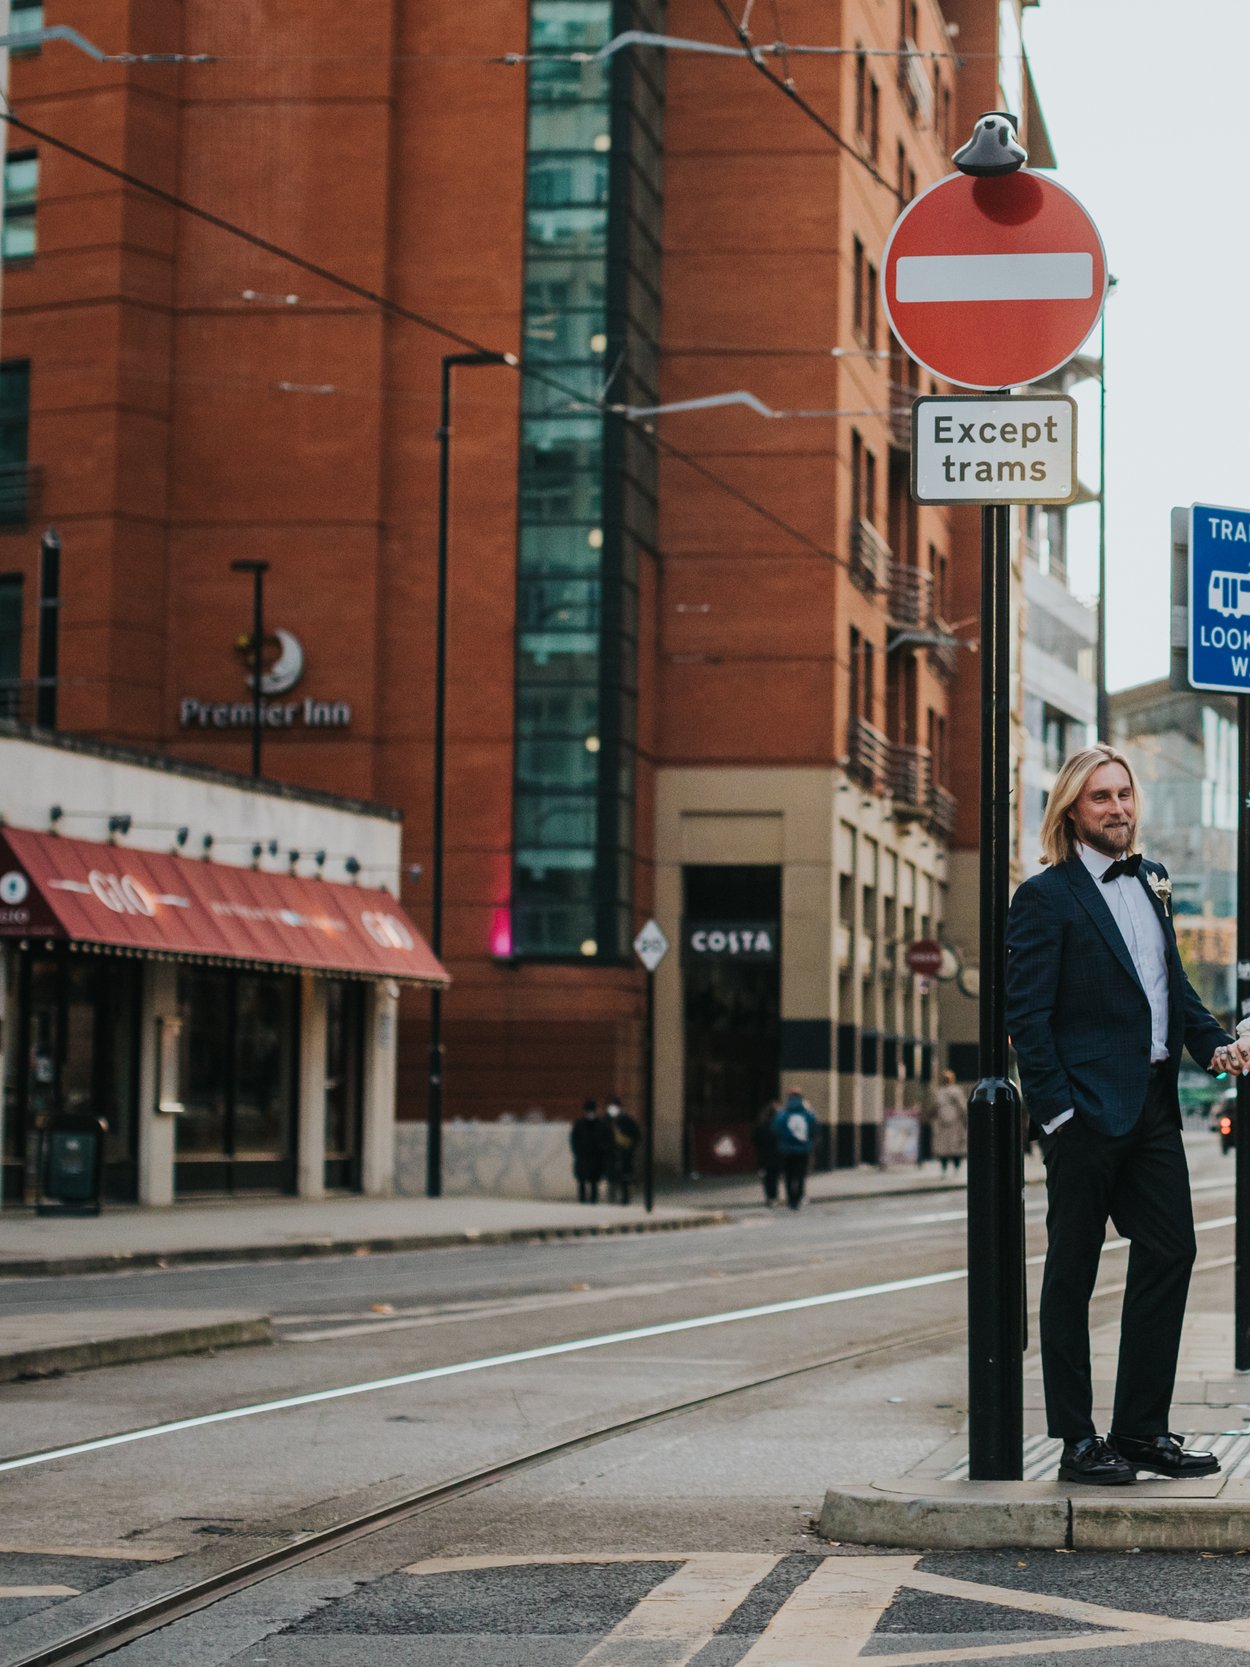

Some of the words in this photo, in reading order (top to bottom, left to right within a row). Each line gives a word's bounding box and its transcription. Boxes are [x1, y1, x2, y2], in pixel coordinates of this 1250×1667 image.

[934, 415, 1058, 448] Except
[942, 454, 1047, 482] trams
[180, 698, 297, 726] Premier
[303, 698, 351, 726] Inn
[691, 930, 772, 954] COSTA
